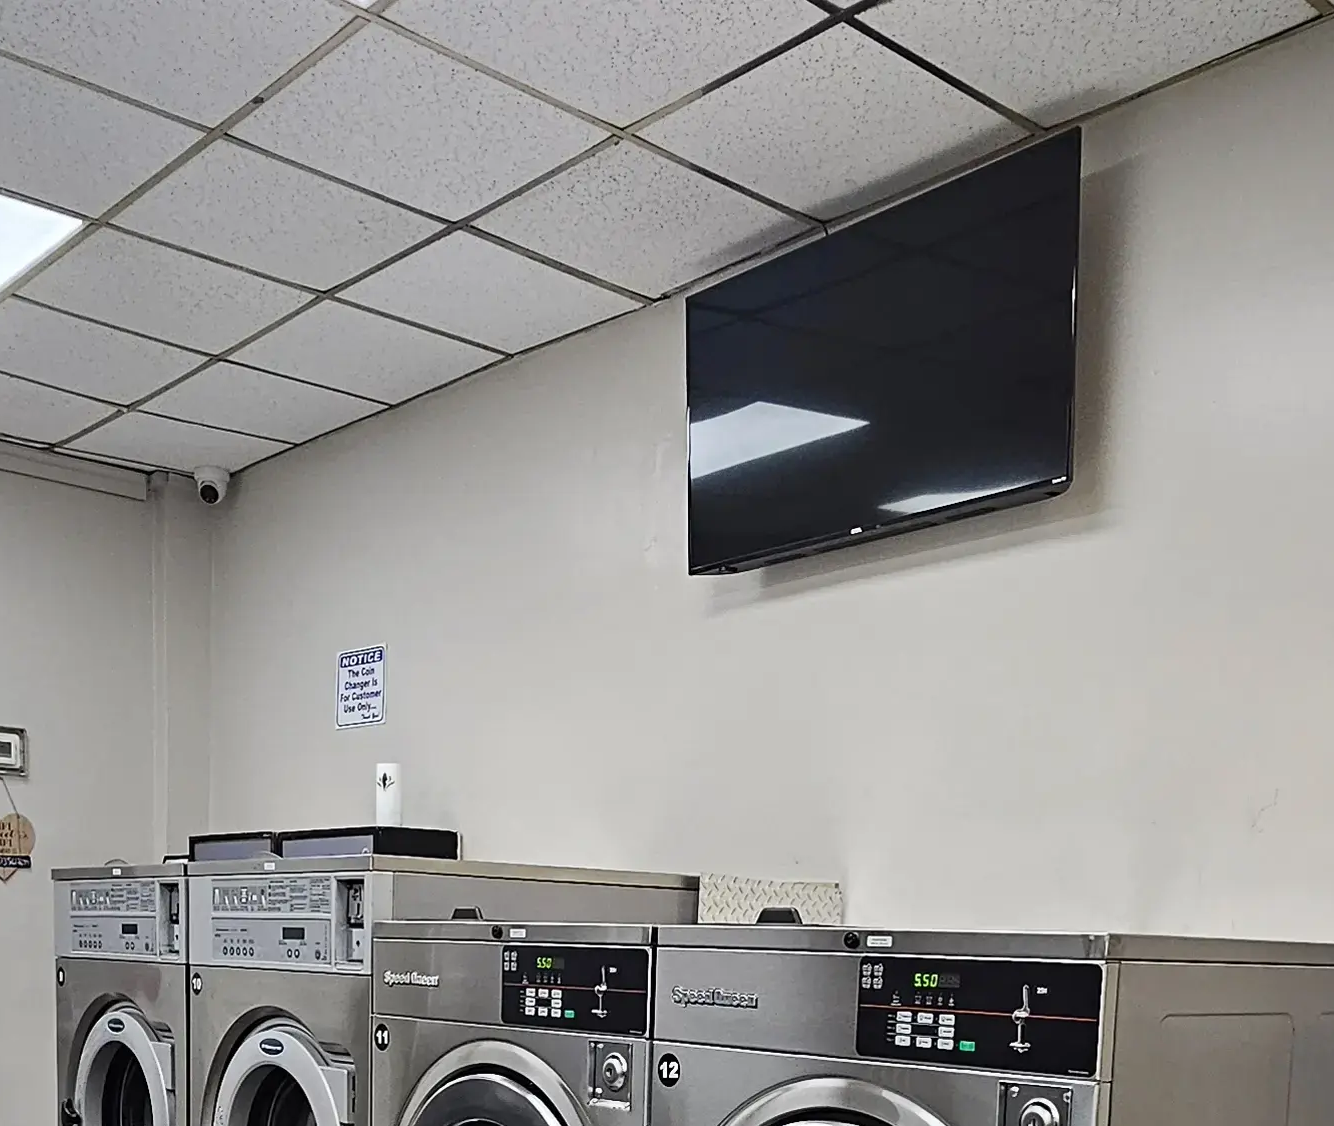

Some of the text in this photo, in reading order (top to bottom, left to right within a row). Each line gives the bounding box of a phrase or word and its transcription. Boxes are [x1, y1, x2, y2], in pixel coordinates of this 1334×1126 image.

[342, 651, 381, 668] NOTICE
[348, 667, 375, 678] The Coin
[345, 678, 378, 690] Changer Is
[340, 690, 382, 702] For Customer
[344, 705, 355, 713] Use
[191, 978, 202, 990] 10
[376, 1030, 388, 1045] 11
[659, 1061, 679, 1079] 12
